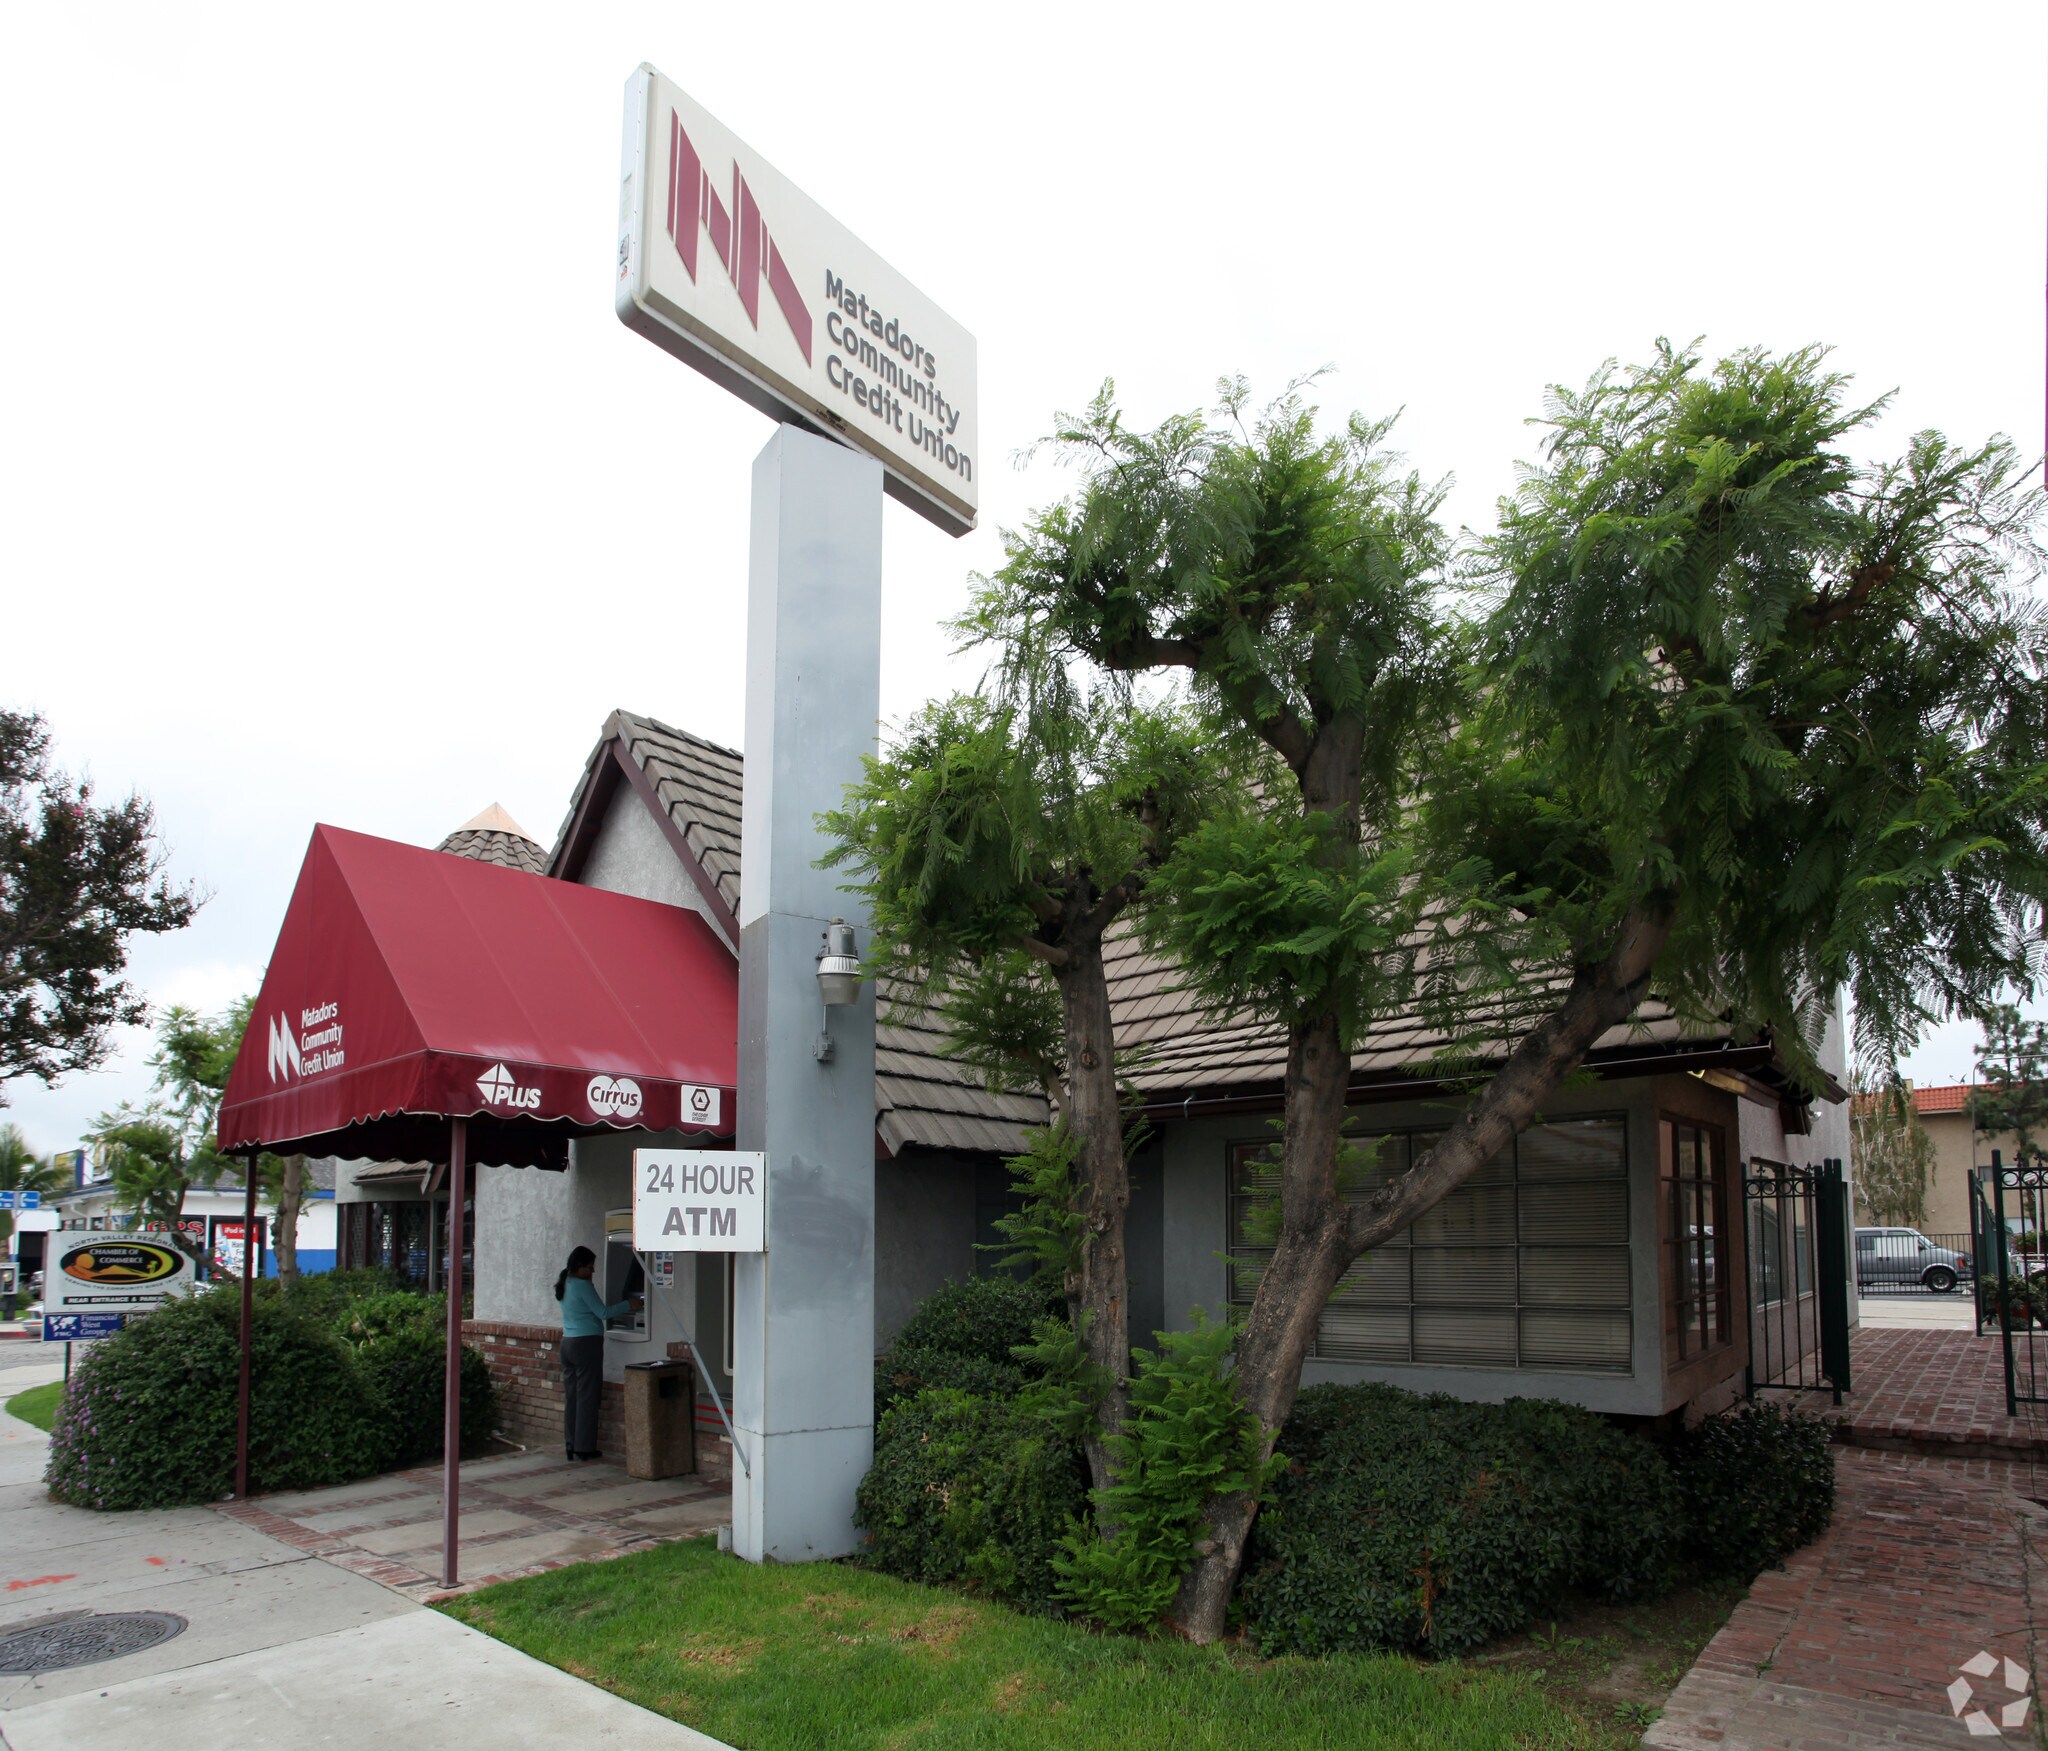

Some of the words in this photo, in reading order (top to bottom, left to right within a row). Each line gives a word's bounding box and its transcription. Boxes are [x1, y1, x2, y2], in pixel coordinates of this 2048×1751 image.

[826, 268, 936, 379] Matadors
[826, 311, 961, 435] Community
[826, 354, 903, 434] Credit
[909, 411, 972, 482] Union
[301, 1002, 338, 1029] Matadors
[301, 1022, 343, 1052] Community
[300, 1053, 323, 1077] Credit
[323, 1048, 344, 1070] Union
[494, 1085, 542, 1109] PLUS
[590, 1085, 638, 1106] Cirrus
[646, 1163, 674, 1193] 24
[682, 1165, 755, 1195] HOUR
[224, 1226, 238, 1234] iPod
[662, 1207, 737, 1237] ATM
[68, 1237, 98, 1249] NORTH
[89, 1248, 127, 1256] CHAMBER
[128, 1248, 140, 1256] OF
[99, 1257, 143, 1265] COMMERCE
[91, 1296, 130, 1304] ENTRANCE
[80, 1314, 118, 1322] Financial
[80, 1328, 107, 1337] Group
